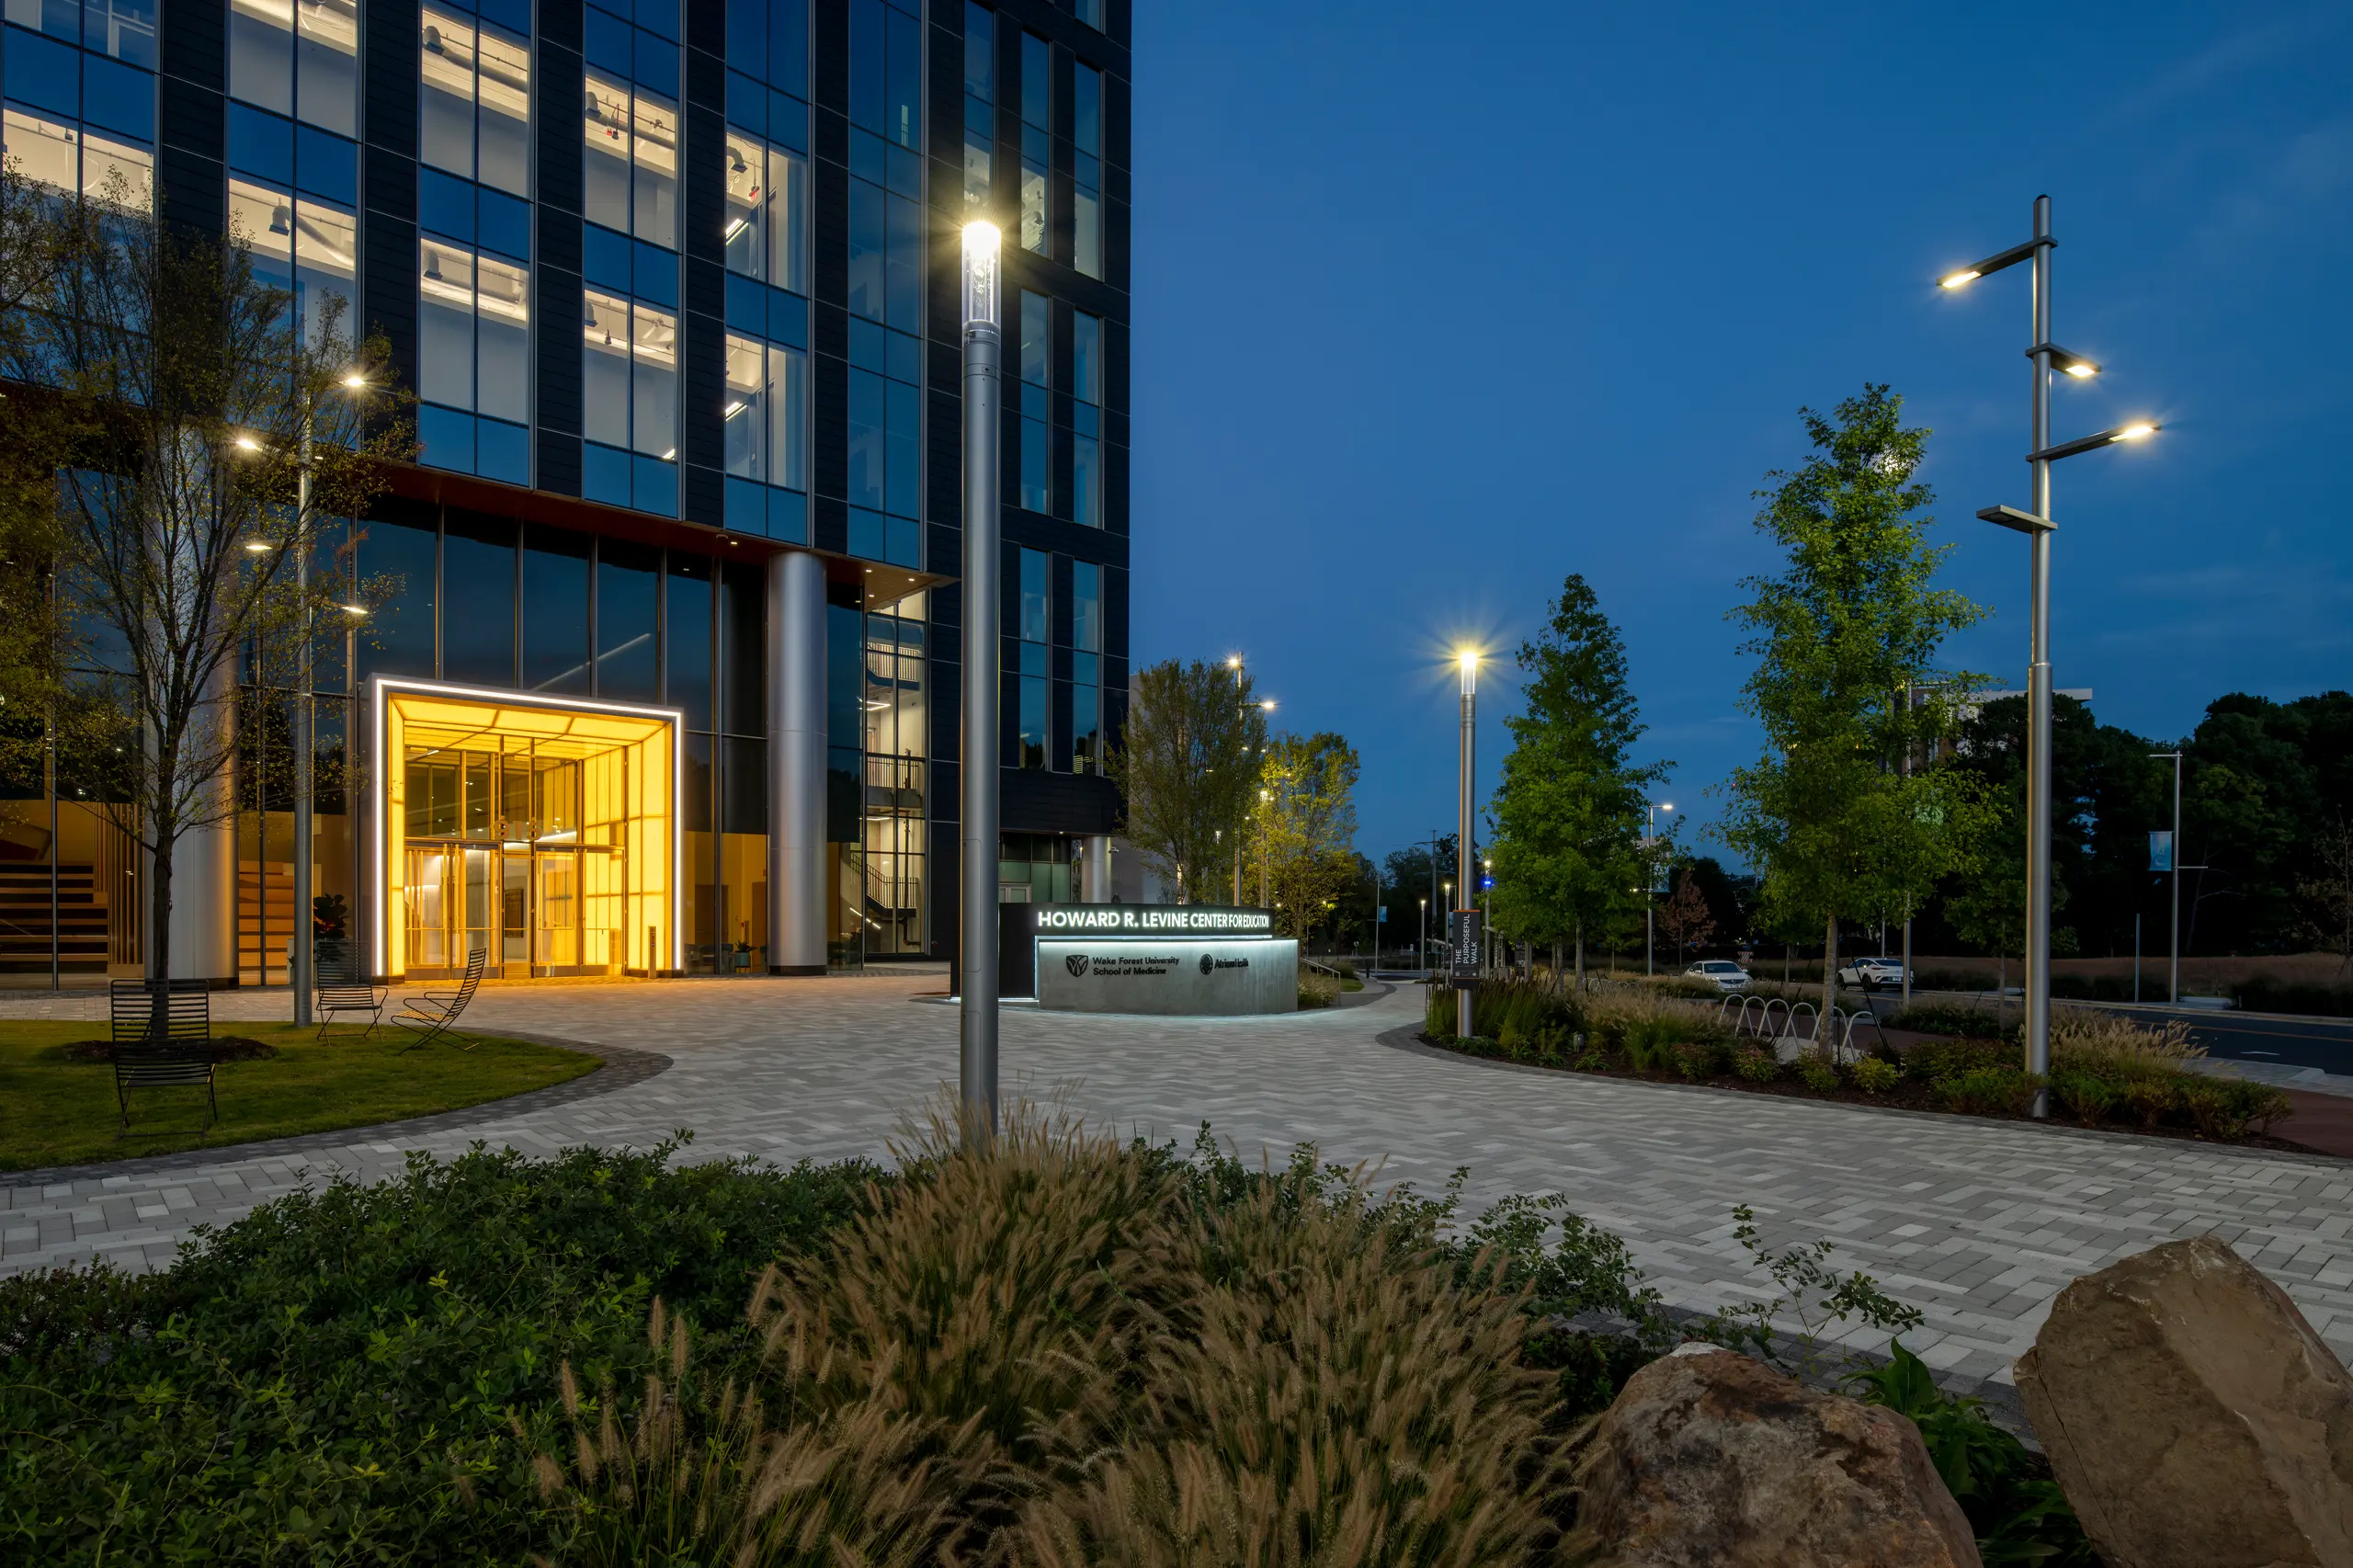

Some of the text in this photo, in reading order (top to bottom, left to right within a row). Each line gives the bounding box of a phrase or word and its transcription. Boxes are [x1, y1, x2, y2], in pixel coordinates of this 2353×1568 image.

[1038, 912, 1269, 927] HOWARD R. LEVINE CENTER FOR EDUCATION
[1092, 957, 1179, 966] Wake Forest University
[1093, 967, 1166, 975] School of Medicine
